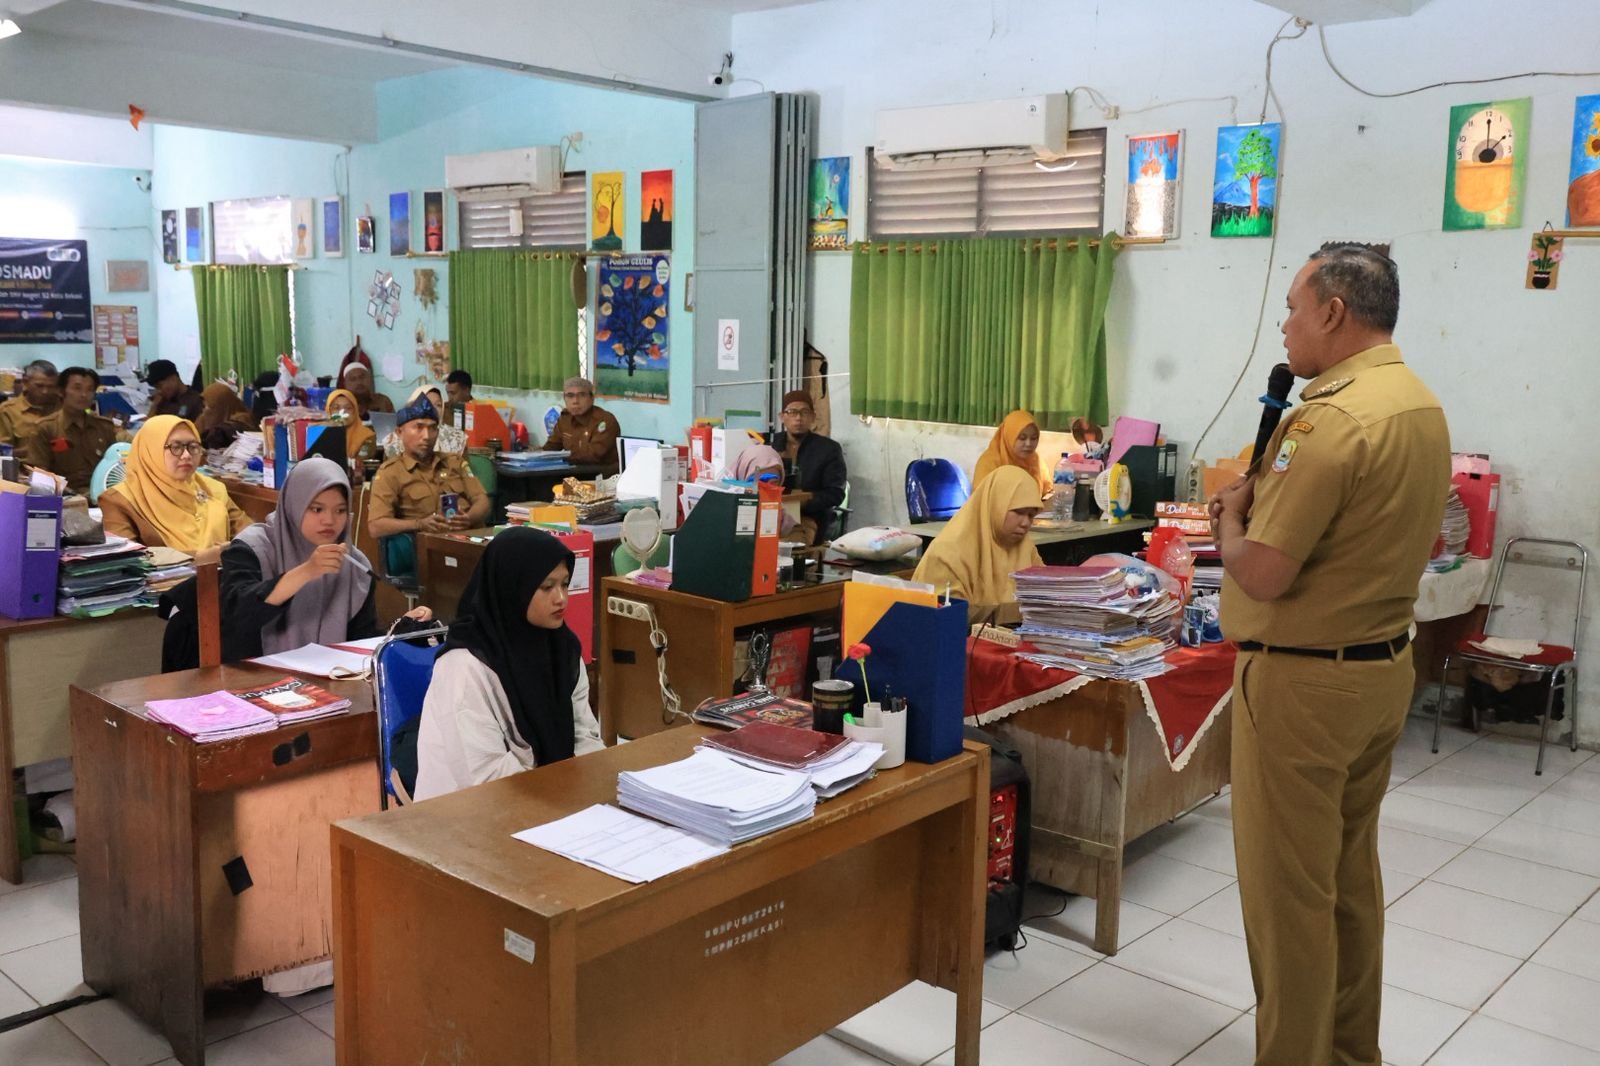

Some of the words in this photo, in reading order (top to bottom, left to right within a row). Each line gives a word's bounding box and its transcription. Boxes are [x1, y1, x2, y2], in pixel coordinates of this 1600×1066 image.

[1485, 110, 1493, 118] 12
[0, 264, 52, 280] SMADU
[236, 680, 303, 699] CAMPUS
